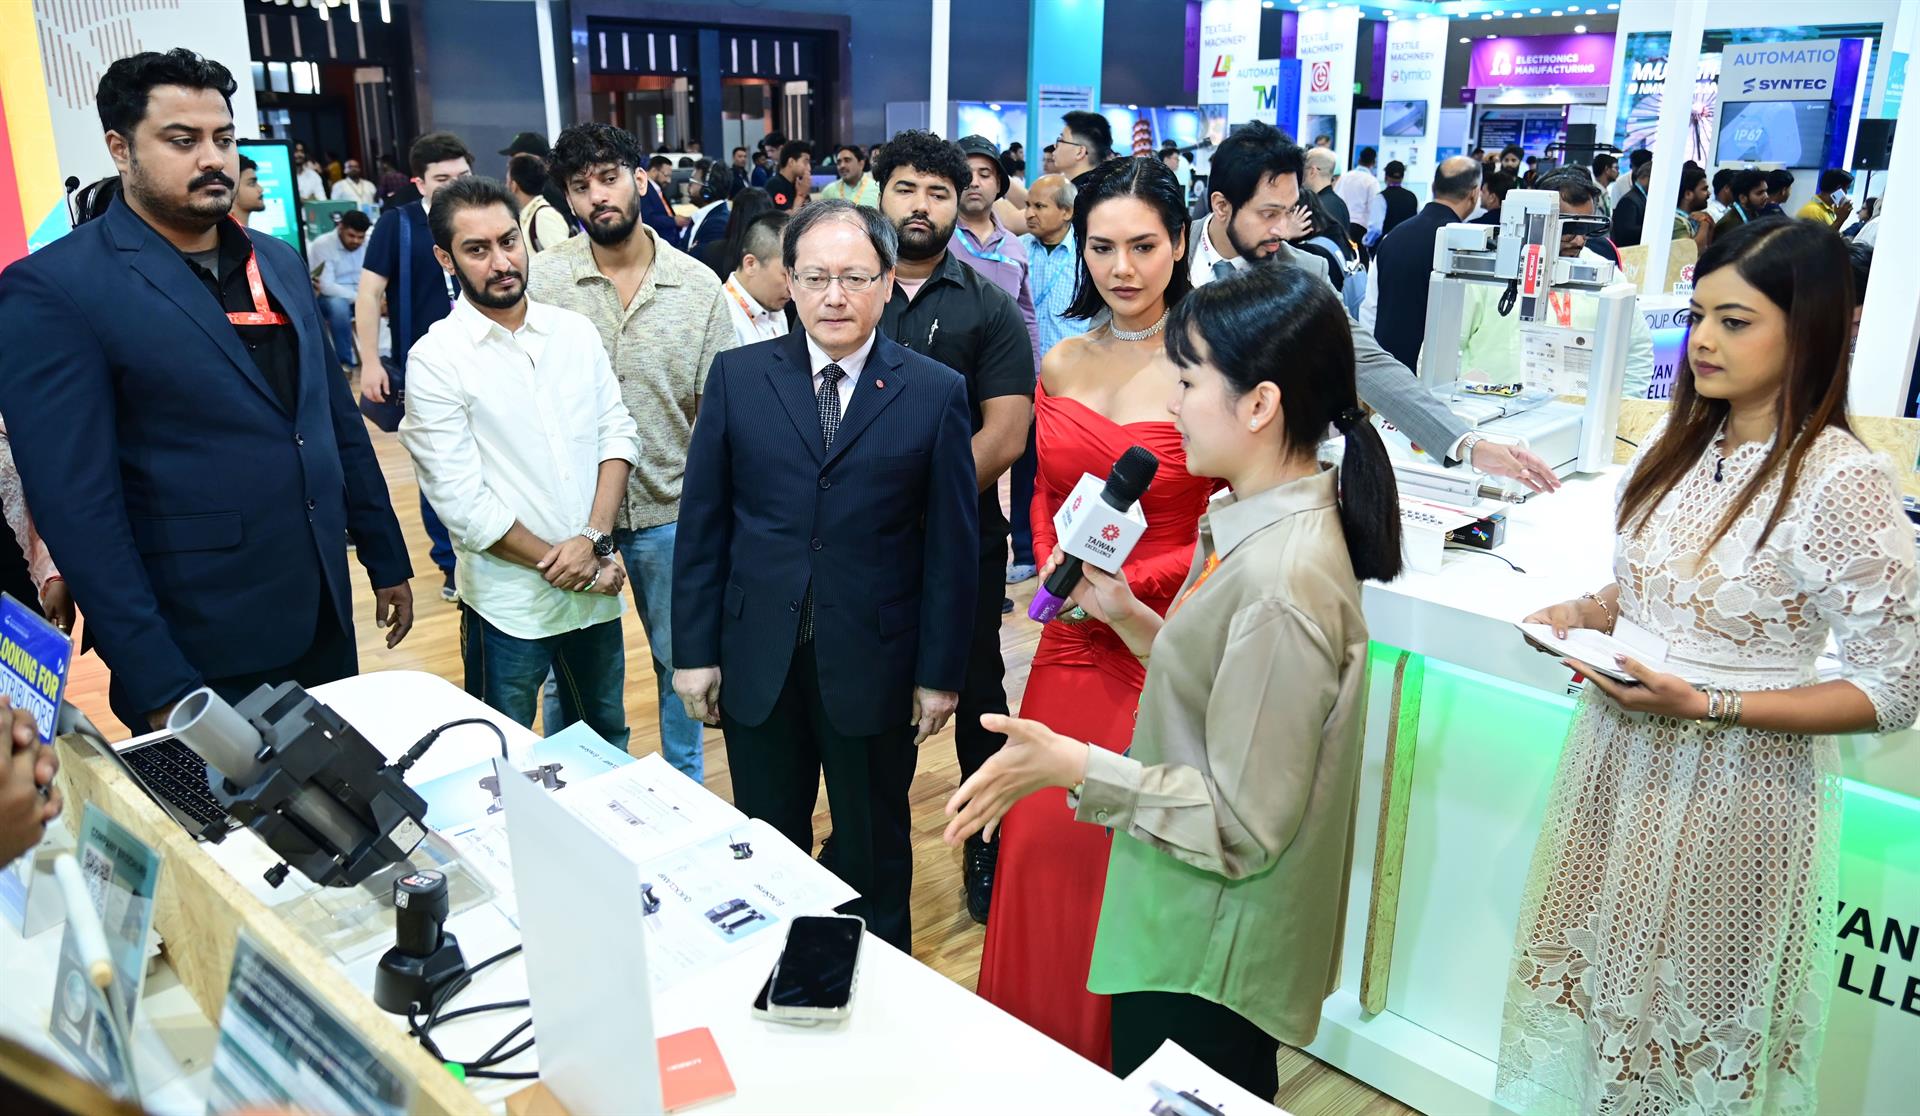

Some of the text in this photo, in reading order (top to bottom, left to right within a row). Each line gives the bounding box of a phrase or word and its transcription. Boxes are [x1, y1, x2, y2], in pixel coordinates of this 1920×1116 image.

[1205, 23, 1232, 33] TEXTILE
[1205, 35, 1246, 47] MACHINERY
[1301, 32, 1329, 42] TEXTILE
[1301, 43, 1344, 55] MACHINERY
[1391, 41, 1420, 50] TEXTILE
[1391, 52, 1434, 61] MACHINERY
[1516, 53, 1579, 65] ELECTRONICS
[1515, 63, 1595, 75] MANUFACTURING
[1759, 78, 1828, 90] SYNTEC
[1734, 128, 1764, 141] IP67
[1085, 543, 1112, 558] EXCELLENCE
[1087, 535, 1116, 554] TAIWAN
[37, 664, 60, 702] FOR
[0, 668, 54, 733] STRIBUTORS
[1837, 900, 1920, 962] AN
